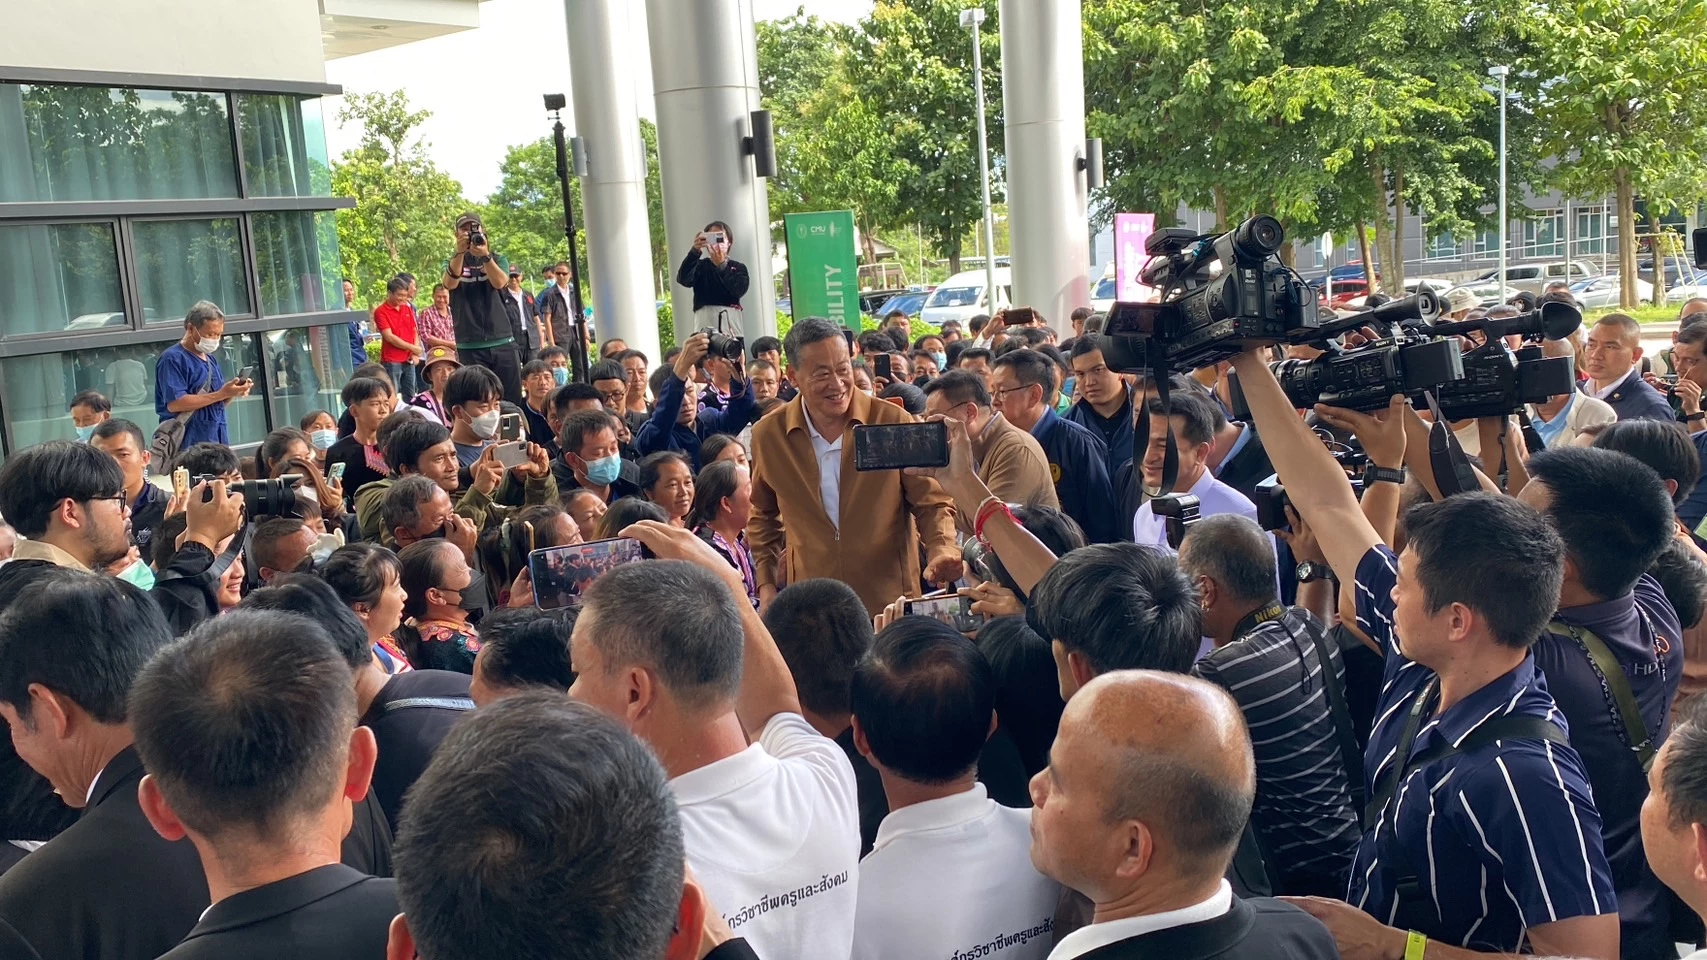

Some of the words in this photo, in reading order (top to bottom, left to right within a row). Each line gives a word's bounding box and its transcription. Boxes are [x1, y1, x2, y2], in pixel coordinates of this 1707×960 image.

[810, 225, 826, 233] CMU
[722, 870, 848, 929] ์กรวิชาชีพครูและสังคม
